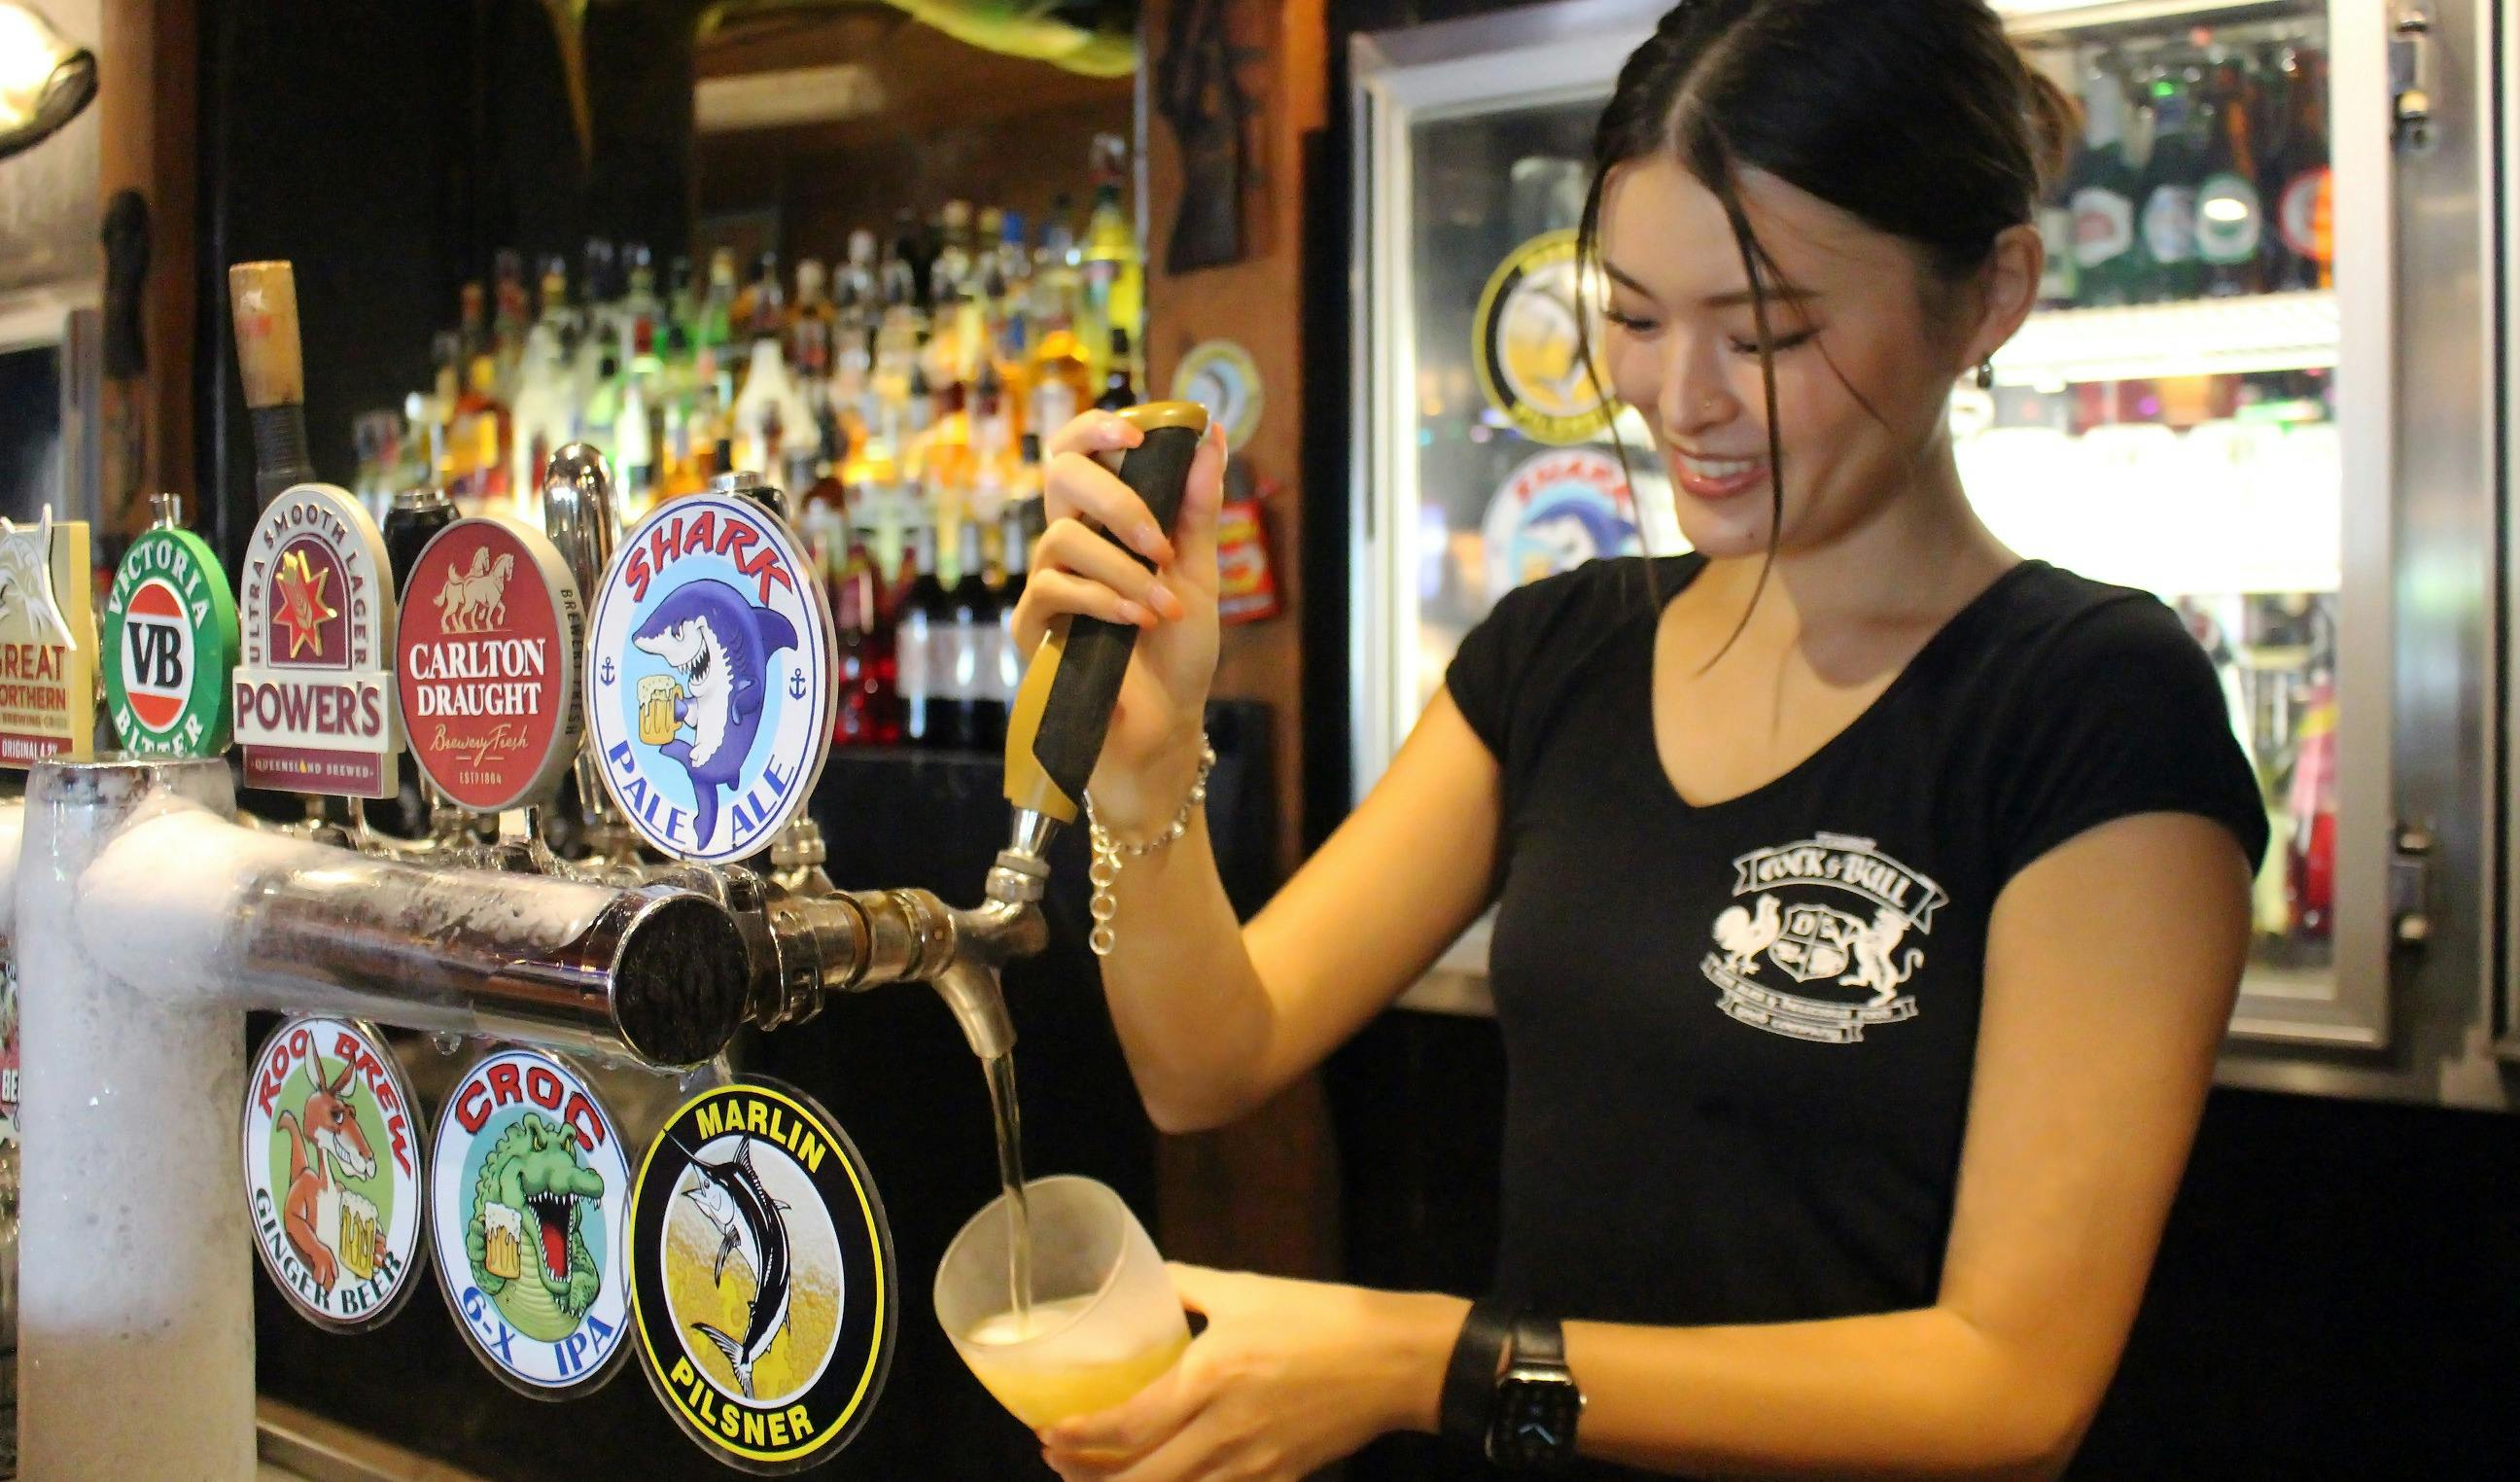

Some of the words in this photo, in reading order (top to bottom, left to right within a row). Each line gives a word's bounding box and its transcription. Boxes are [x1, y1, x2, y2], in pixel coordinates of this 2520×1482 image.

[108, 541, 209, 628] VICTORIA
[250, 560, 265, 663] ULTRA
[263, 504, 348, 550] SMOOTH
[345, 550, 368, 665] LAGER
[624, 511, 793, 609] SHARK
[0, 644, 65, 681] REAT
[126, 620, 183, 688] VB
[409, 638, 546, 681] CARLTON
[0, 685, 66, 711] ORTHERN
[115, 702, 204, 755] BITTER
[237, 682, 380, 737] POWER'S
[417, 683, 542, 717] DRAUGHT
[2, 739, 38, 759] ORIGINAL
[327, 763, 369, 779] BREWED
[430, 723, 487, 767] Brewery
[489, 723, 529, 752] Fresh
[609, 740, 687, 845] PALE
[731, 755, 794, 847] ALE
[258, 1029, 308, 1119] ROO
[333, 1032, 411, 1181] BREW
[455, 1063, 606, 1153] CROC
[695, 1099, 827, 1174] MARLIN
[256, 1187, 332, 1312] GINGER
[341, 1251, 403, 1316] BEER
[462, 1287, 517, 1364] 6-X
[554, 1315, 613, 1377] IPA
[670, 1356, 815, 1446] PILSNER
